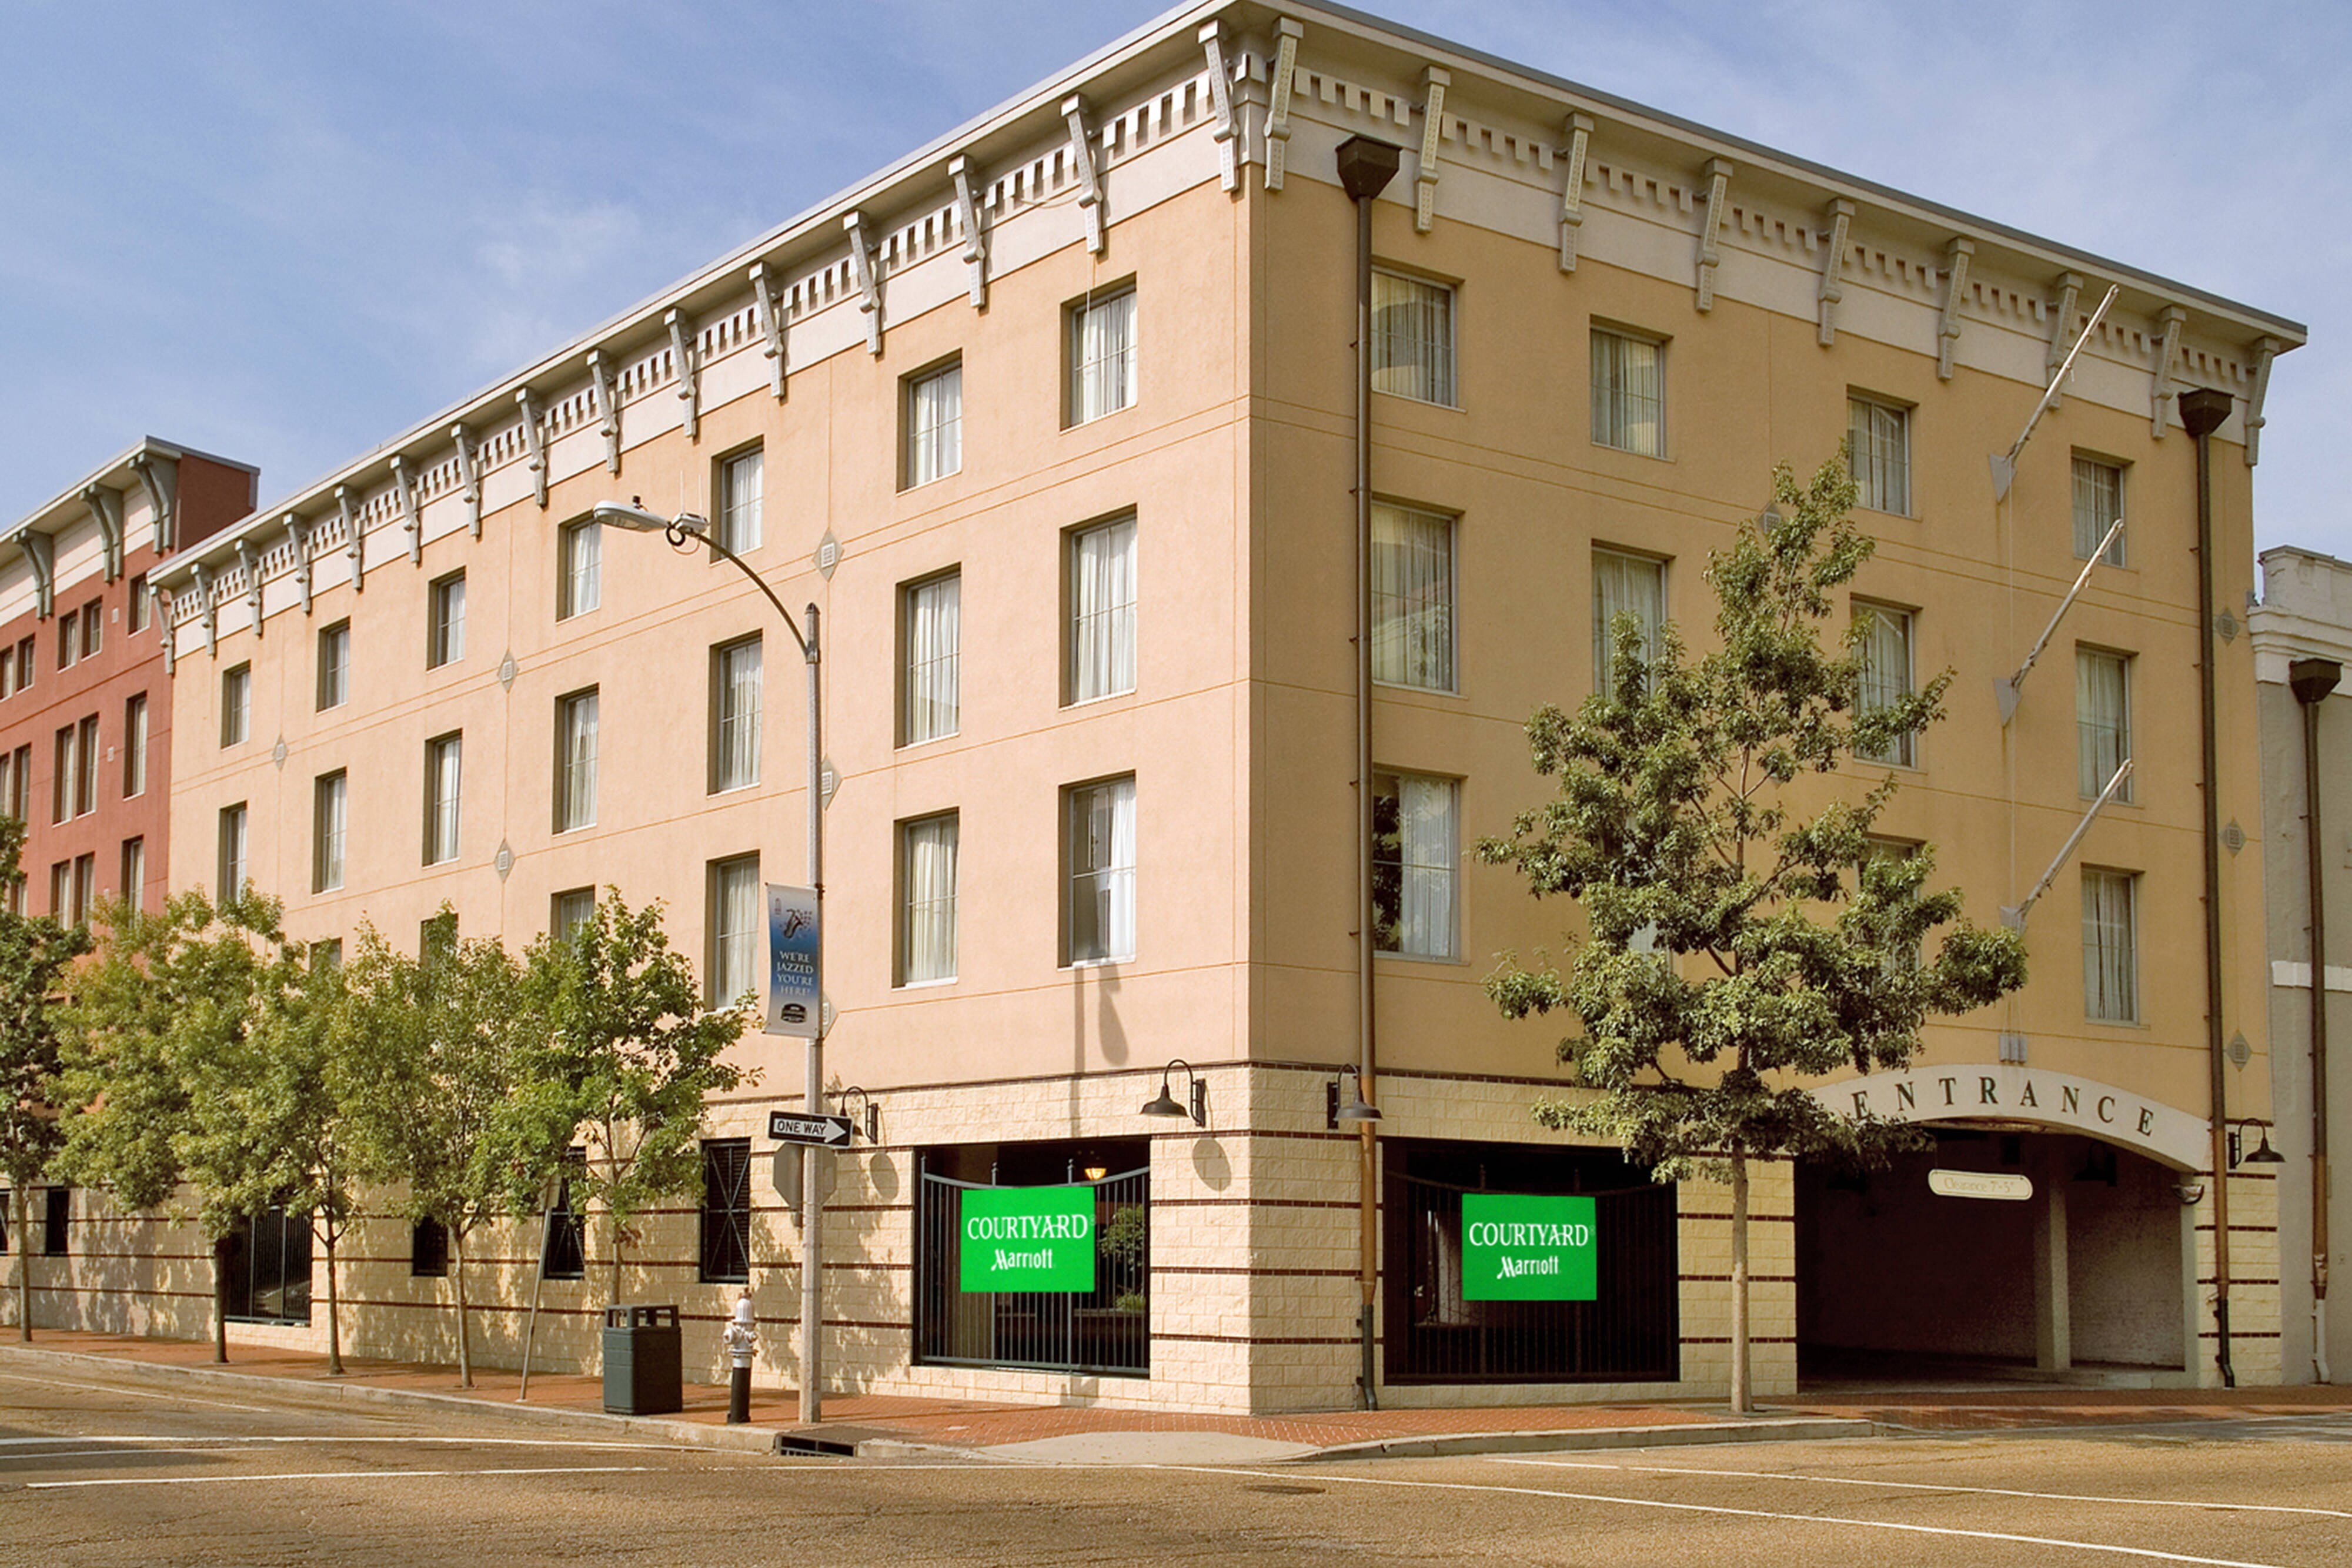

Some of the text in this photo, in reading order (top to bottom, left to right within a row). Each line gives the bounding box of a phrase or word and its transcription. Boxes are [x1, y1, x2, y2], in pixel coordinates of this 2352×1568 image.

[777, 961, 814, 974] JAZZED
[779, 951, 809, 963] WE'RE
[777, 973, 813, 986] YOU'RE
[1851, 1076, 2154, 1136] ENTRANCE
[777, 1120, 826, 1135] ONE WAY
[967, 1214, 1088, 1240] COURTYARD
[1469, 1222, 1589, 1246] COURTYARD
[991, 1249, 1053, 1271] Marriott
[1496, 1256, 1559, 1279] Marriott
